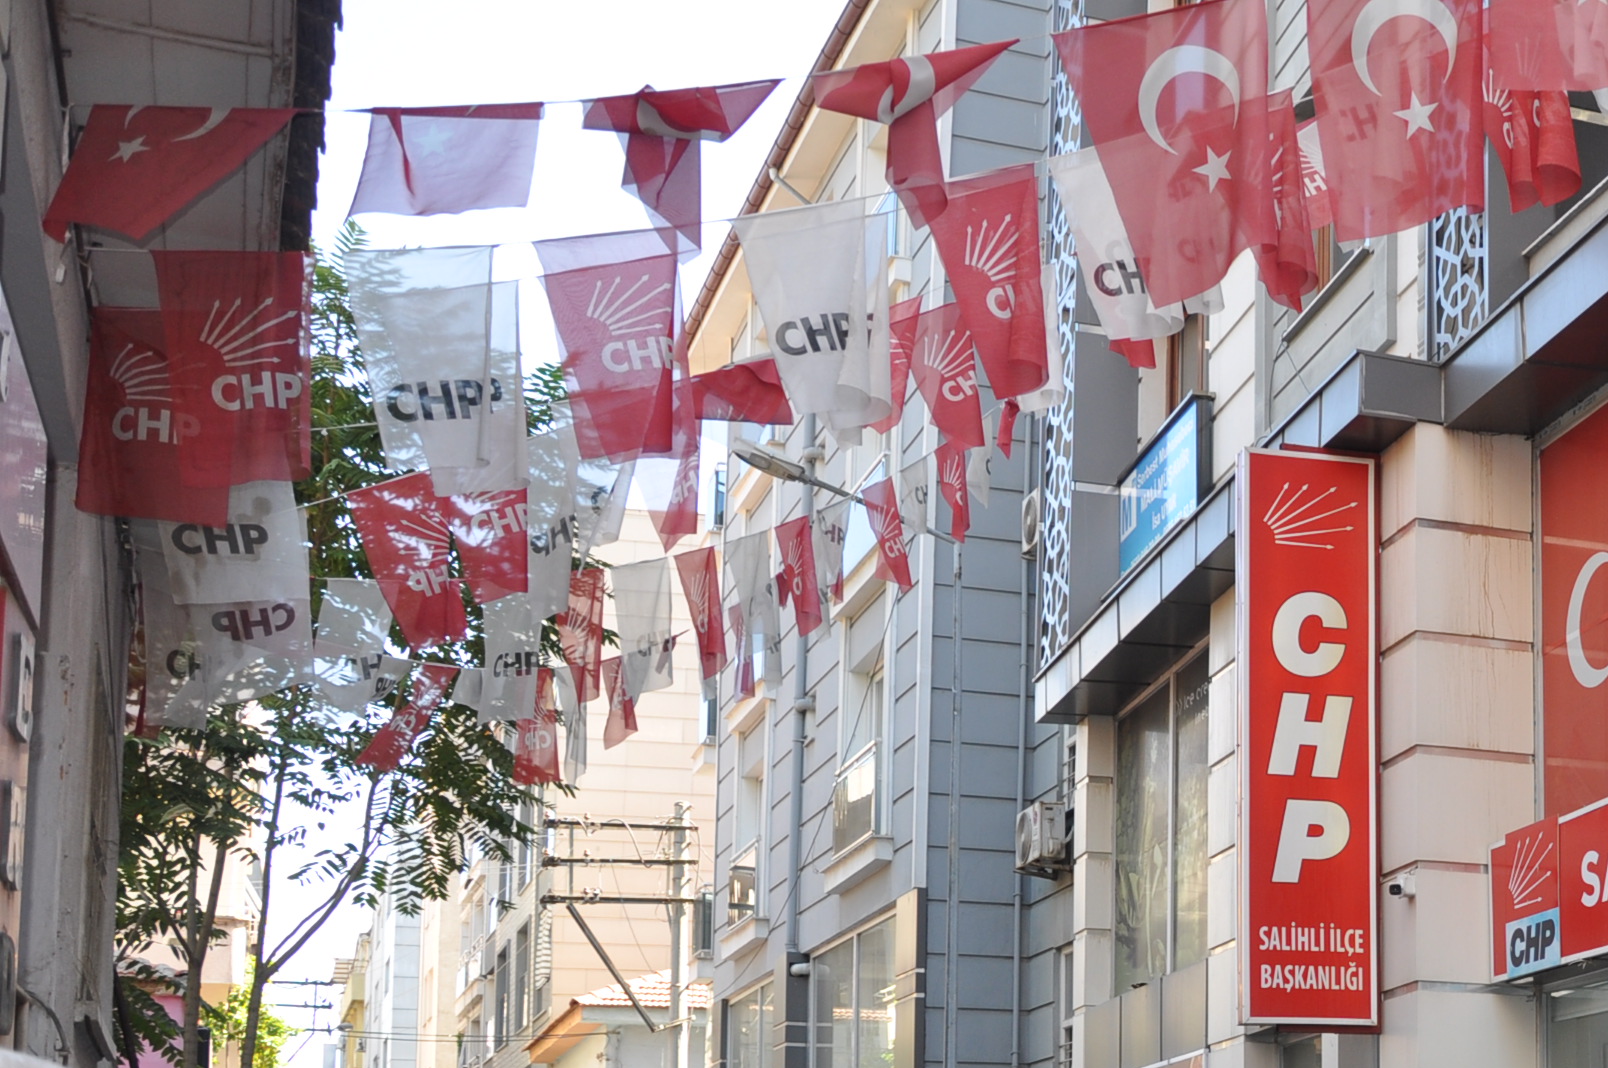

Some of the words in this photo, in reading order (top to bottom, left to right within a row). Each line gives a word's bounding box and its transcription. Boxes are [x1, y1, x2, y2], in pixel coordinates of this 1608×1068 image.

[211, 371, 303, 411] CHP
[386, 380, 483, 423] CHP
[942, 370, 977, 401] CH
[171, 523, 269, 555] CHP
[1266, 591, 1353, 883] CHP
[1259, 921, 1325, 953] SALİHLİ
[1329, 924, 1364, 958] İLÇE
[1509, 918, 1556, 968] CHP
[1260, 961, 1364, 992] BAŞKANLIĞI
